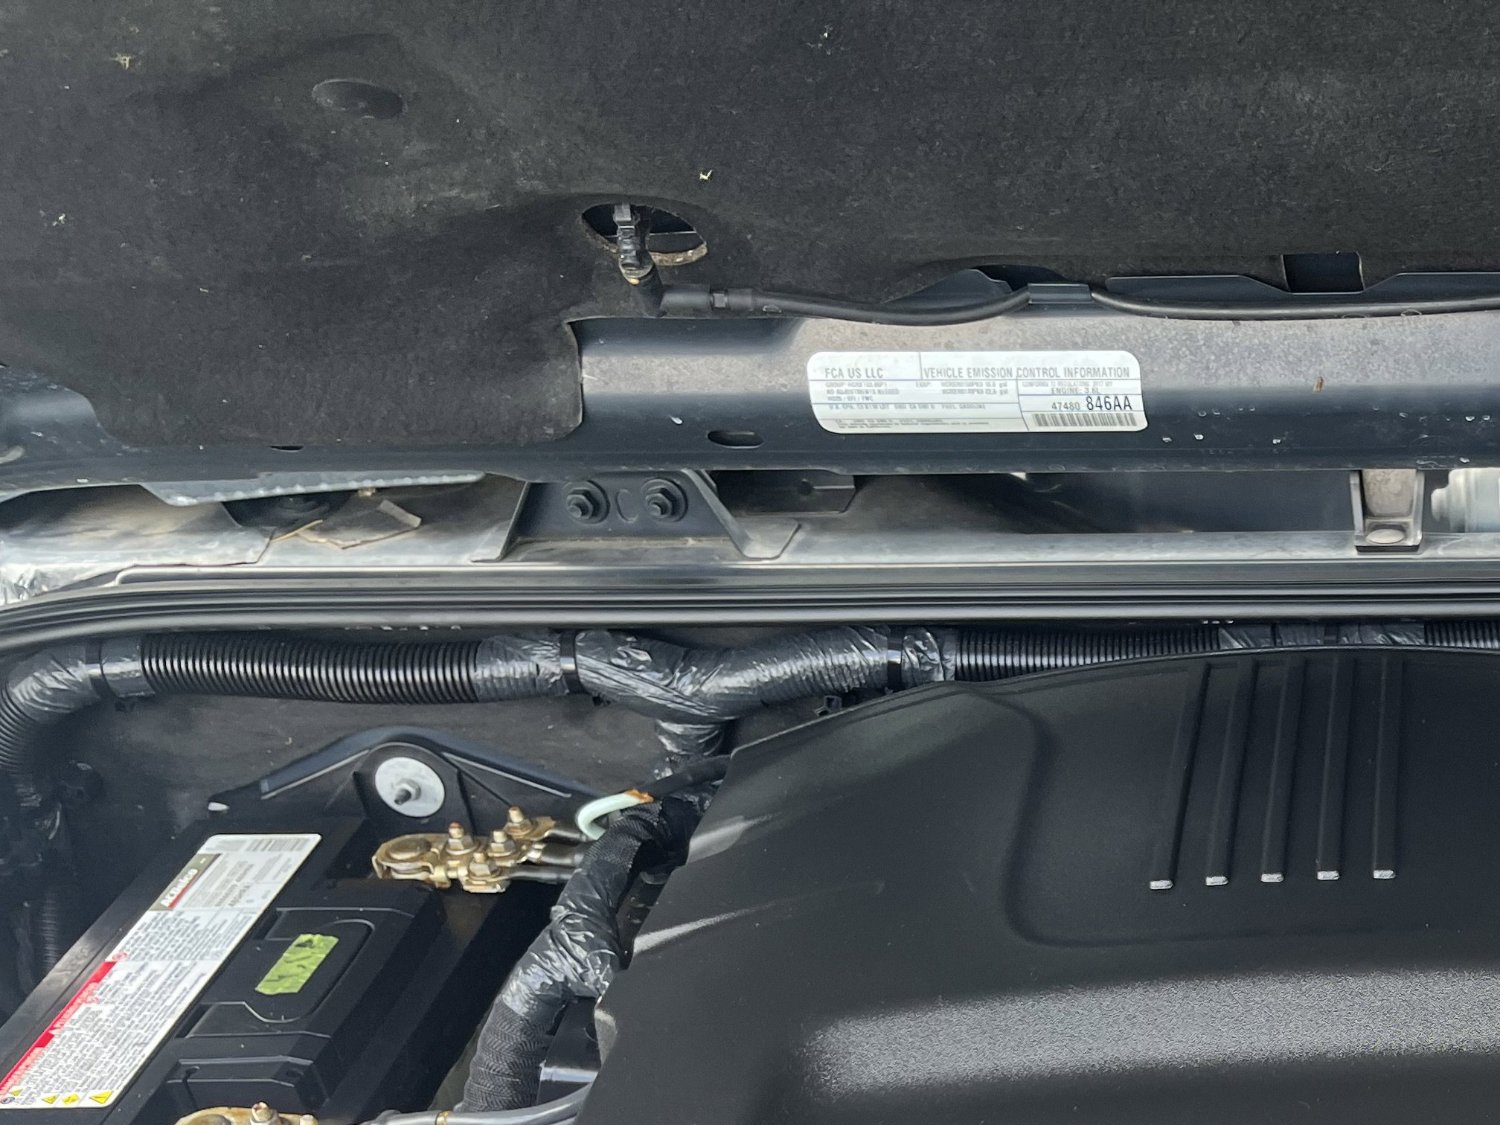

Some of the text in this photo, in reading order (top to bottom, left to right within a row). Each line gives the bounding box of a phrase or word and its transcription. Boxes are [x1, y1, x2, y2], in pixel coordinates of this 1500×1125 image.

[824, 367, 885, 379] FCA US LLC
[923, 367, 1131, 379] VEHICLE EMISSION CONTROL INFORMATION
[1051, 396, 1134, 411] 47480 846AA
